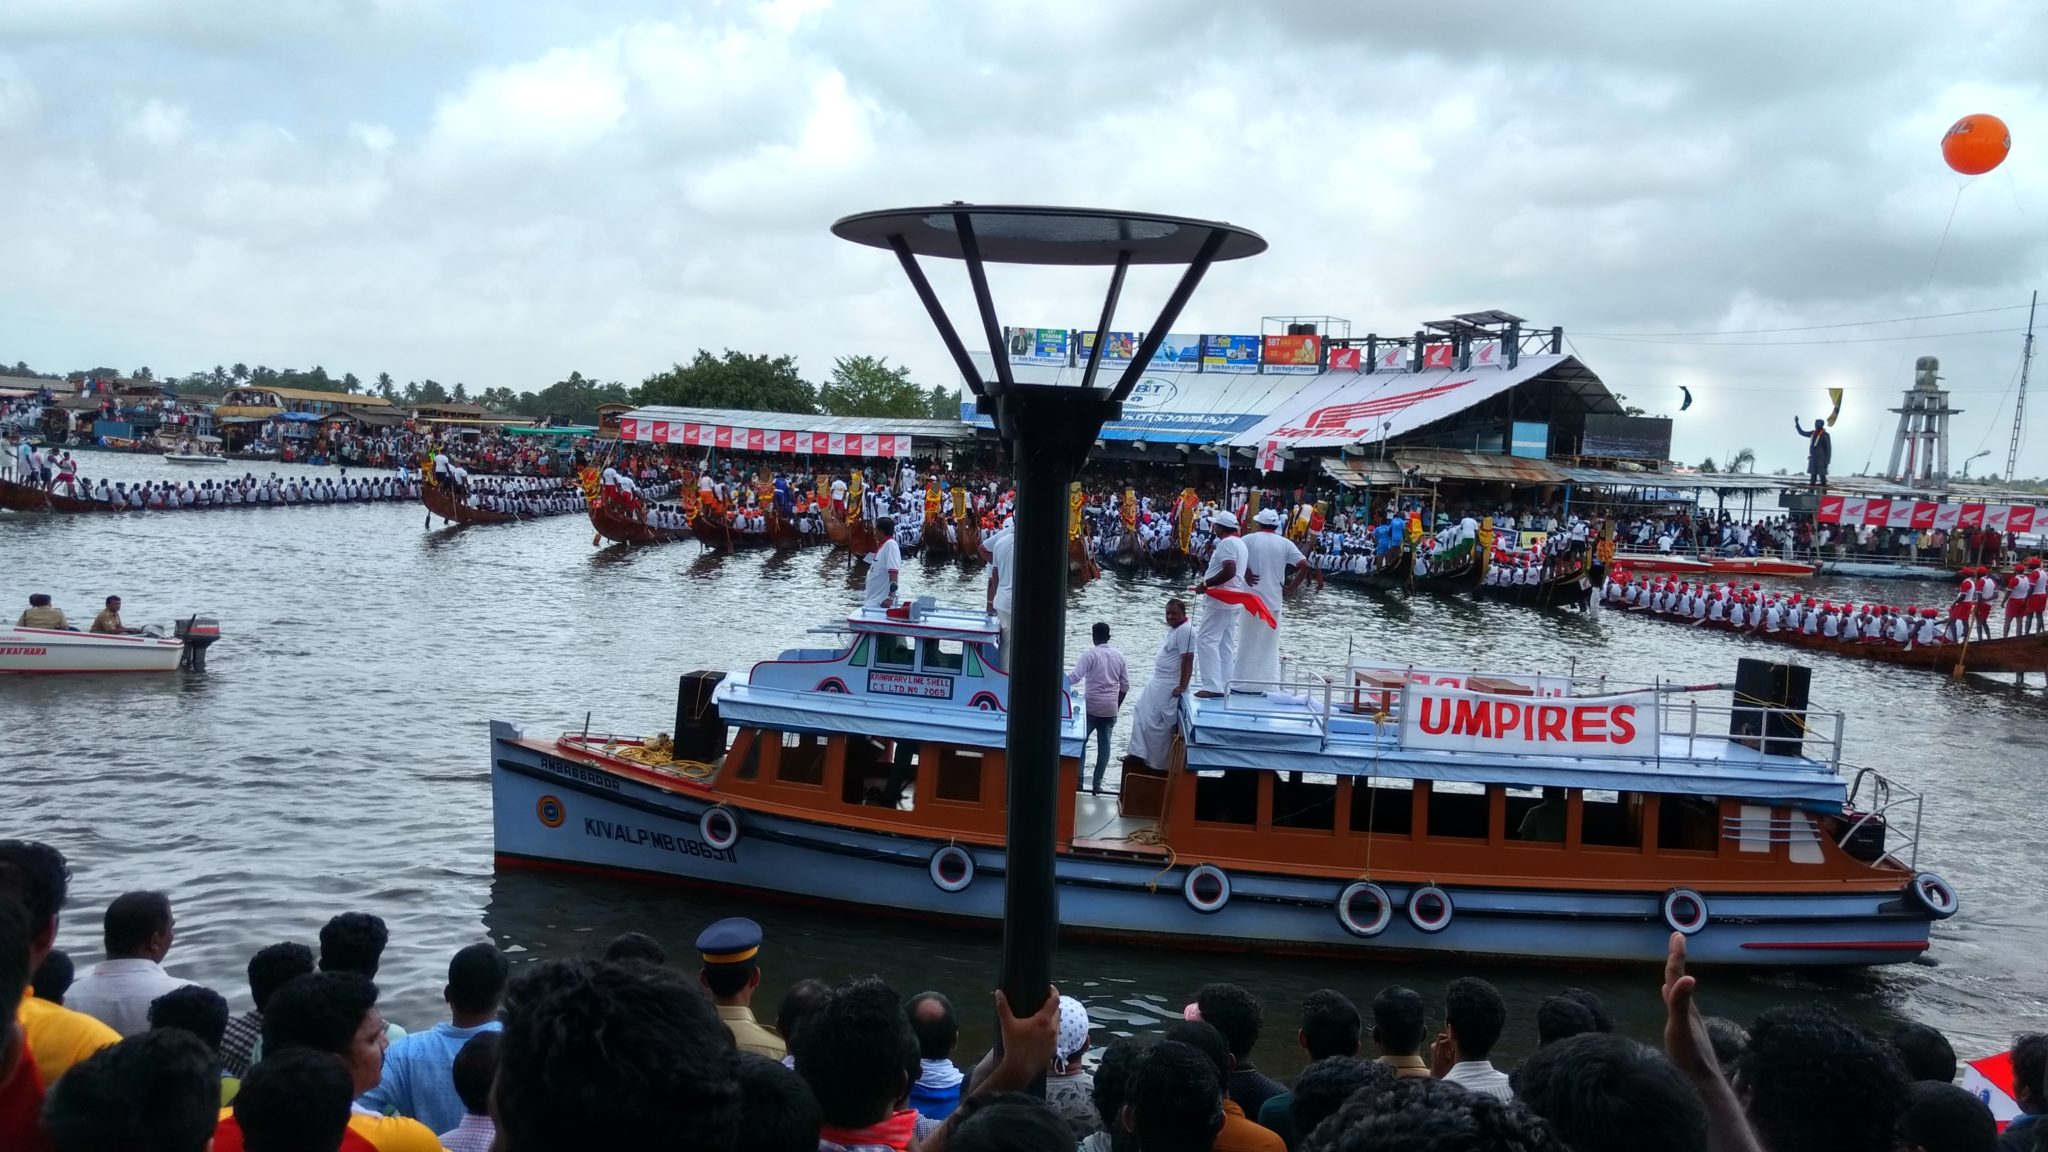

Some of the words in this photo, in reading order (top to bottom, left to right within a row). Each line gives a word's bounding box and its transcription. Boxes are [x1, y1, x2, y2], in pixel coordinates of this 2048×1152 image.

[1267, 338, 1280, 346] SBT
[871, 672, 907, 683] KAINAKARY
[926, 678, 949, 687] SHELL
[1419, 697, 1636, 745] UMPIRES
[540, 758, 621, 791] AMBASSADOR
